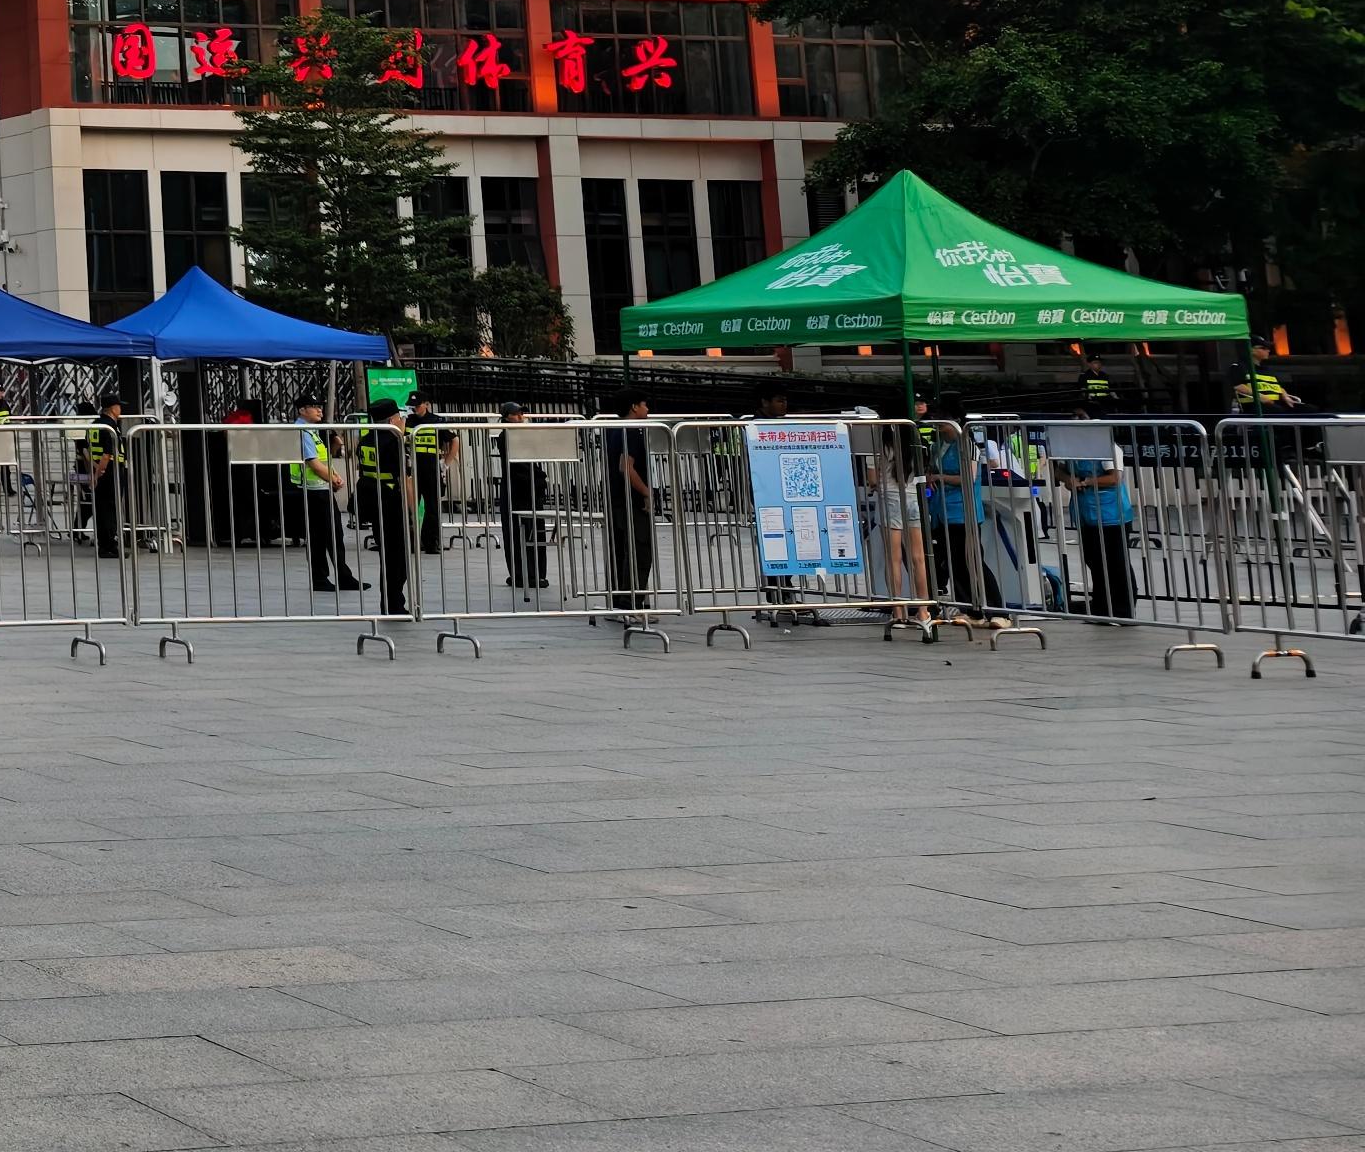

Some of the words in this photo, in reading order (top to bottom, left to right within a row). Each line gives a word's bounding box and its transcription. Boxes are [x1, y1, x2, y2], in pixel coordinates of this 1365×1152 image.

[935, 240, 1017, 267] 你我的
[982, 263, 1072, 287] 怡寶
[758, 431, 837, 443] 未带身份证请扫码
